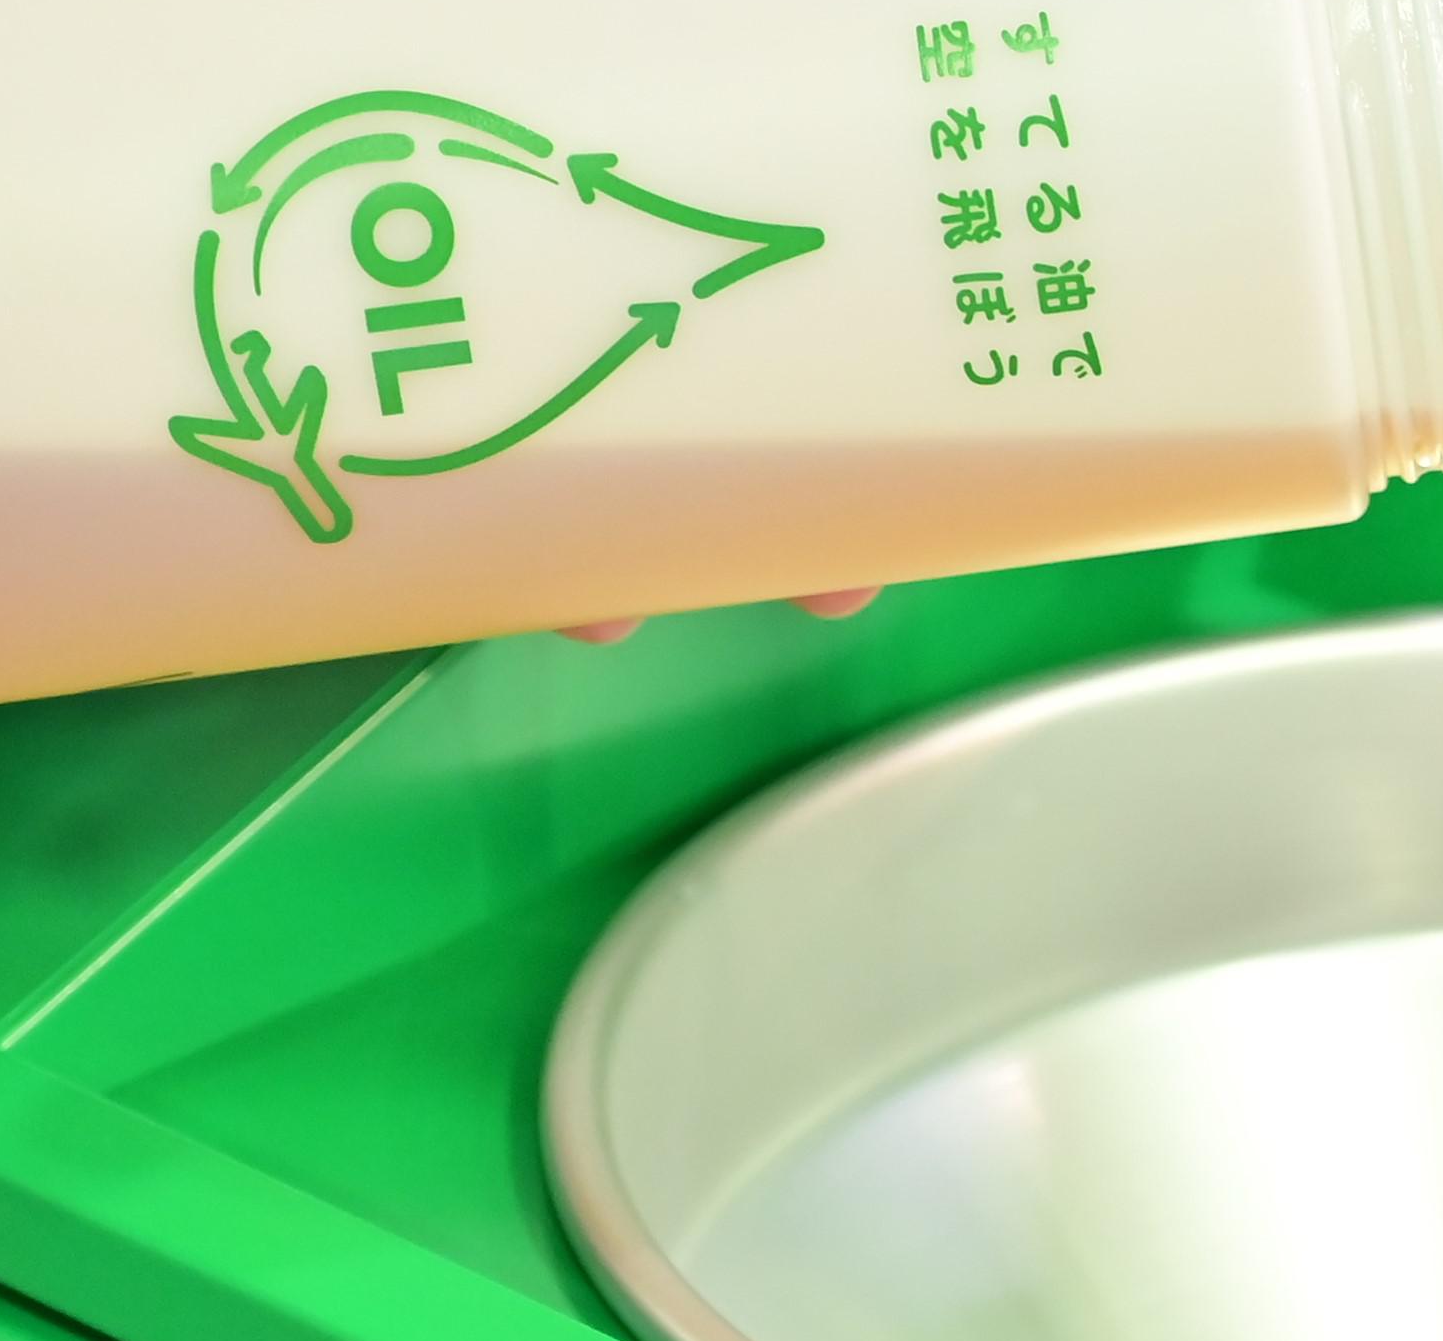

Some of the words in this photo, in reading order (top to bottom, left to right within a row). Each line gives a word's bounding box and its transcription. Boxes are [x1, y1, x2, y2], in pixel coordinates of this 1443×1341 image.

[351, 181, 473, 416] OIL
[915, 20, 1019, 385] 空を飛ぼう
[1001, 10, 1103, 380] すてる油で
